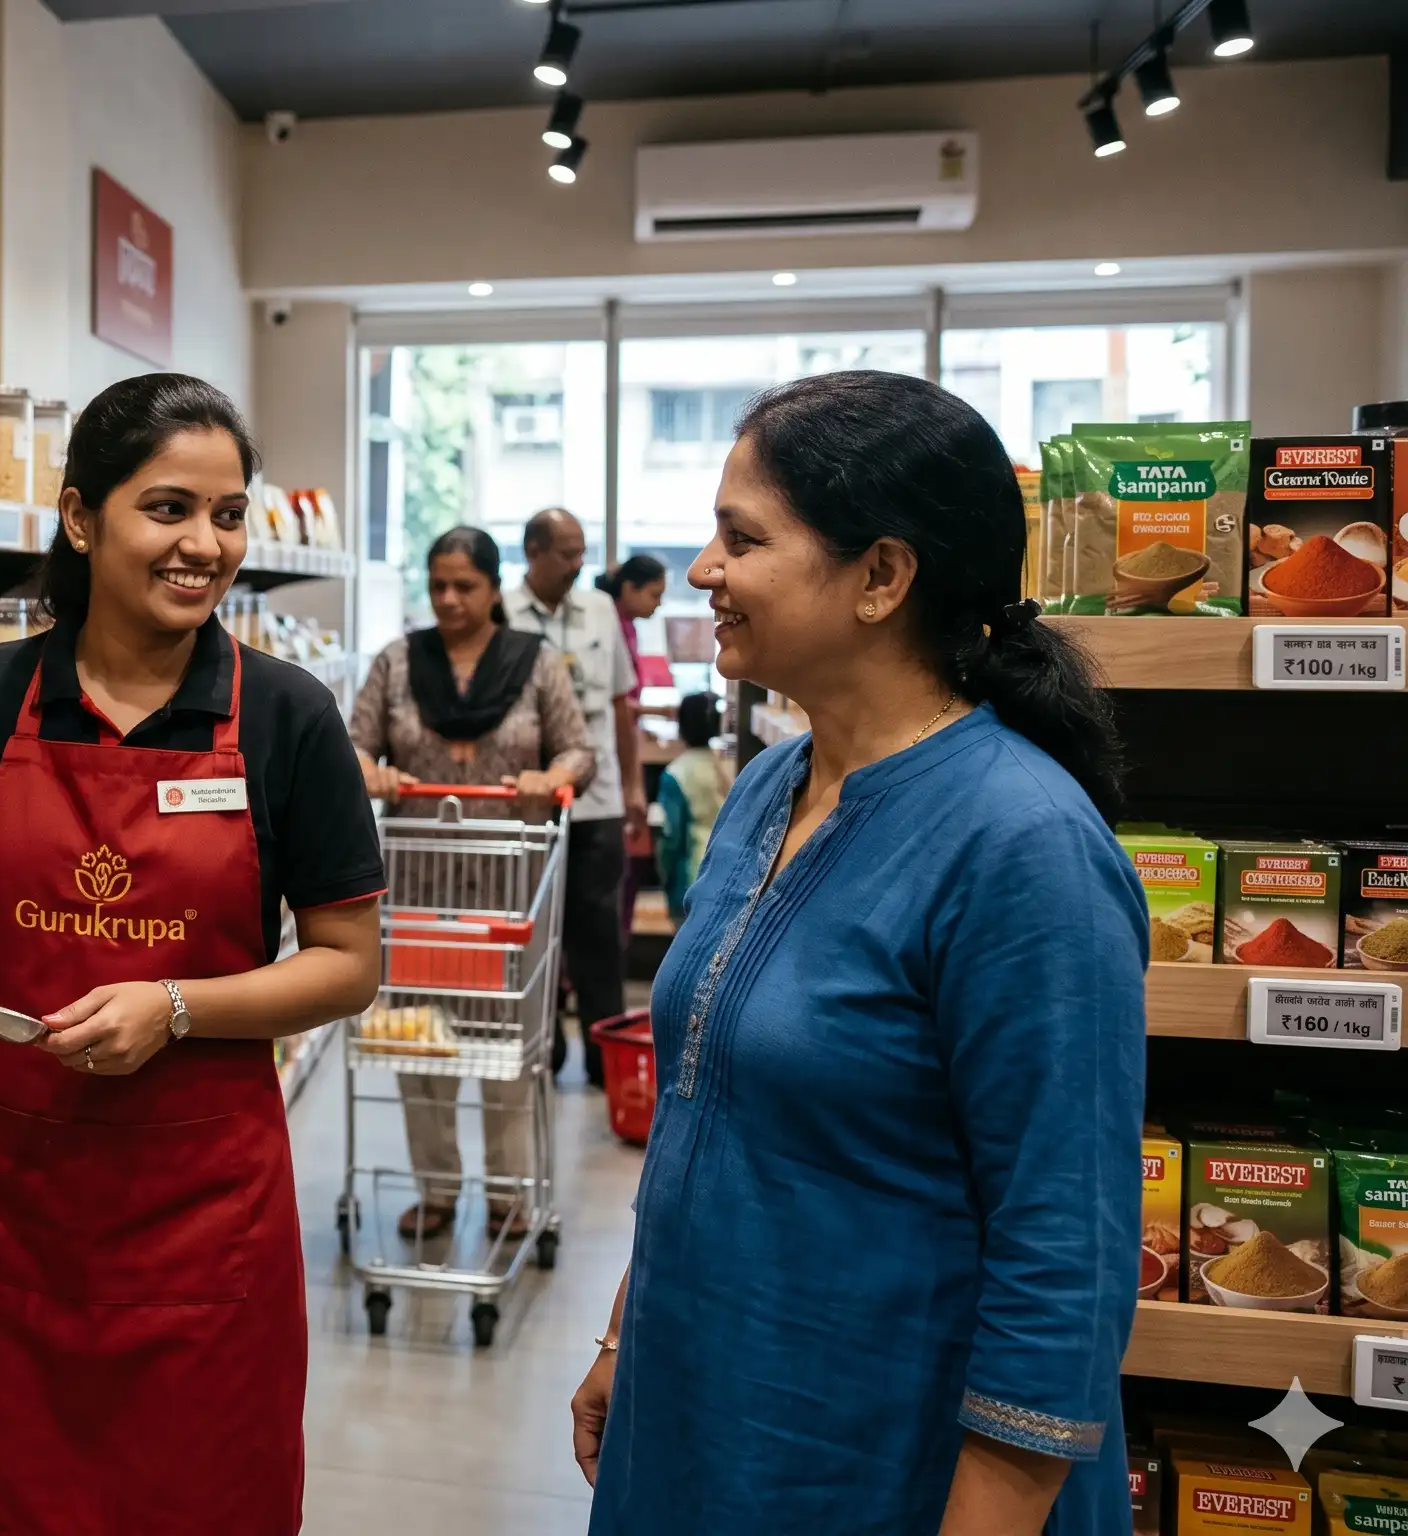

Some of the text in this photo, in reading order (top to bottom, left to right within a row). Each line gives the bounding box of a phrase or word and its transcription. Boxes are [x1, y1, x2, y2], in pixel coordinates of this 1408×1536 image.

[1279, 448, 1359, 466] EVEREST
[1137, 465, 1188, 479] TATA
[1117, 480, 1207, 499] sampann
[1283, 658, 1333, 676] ₹100
[1349, 663, 1377, 679] 1kg
[1282, 1014, 1329, 1032] ₹160
[1344, 1021, 1371, 1037] 1kg
[1209, 1161, 1306, 1186] EVEREST
[1387, 1179, 1408, 1190] TA
[1196, 1491, 1291, 1519] EVEREST
